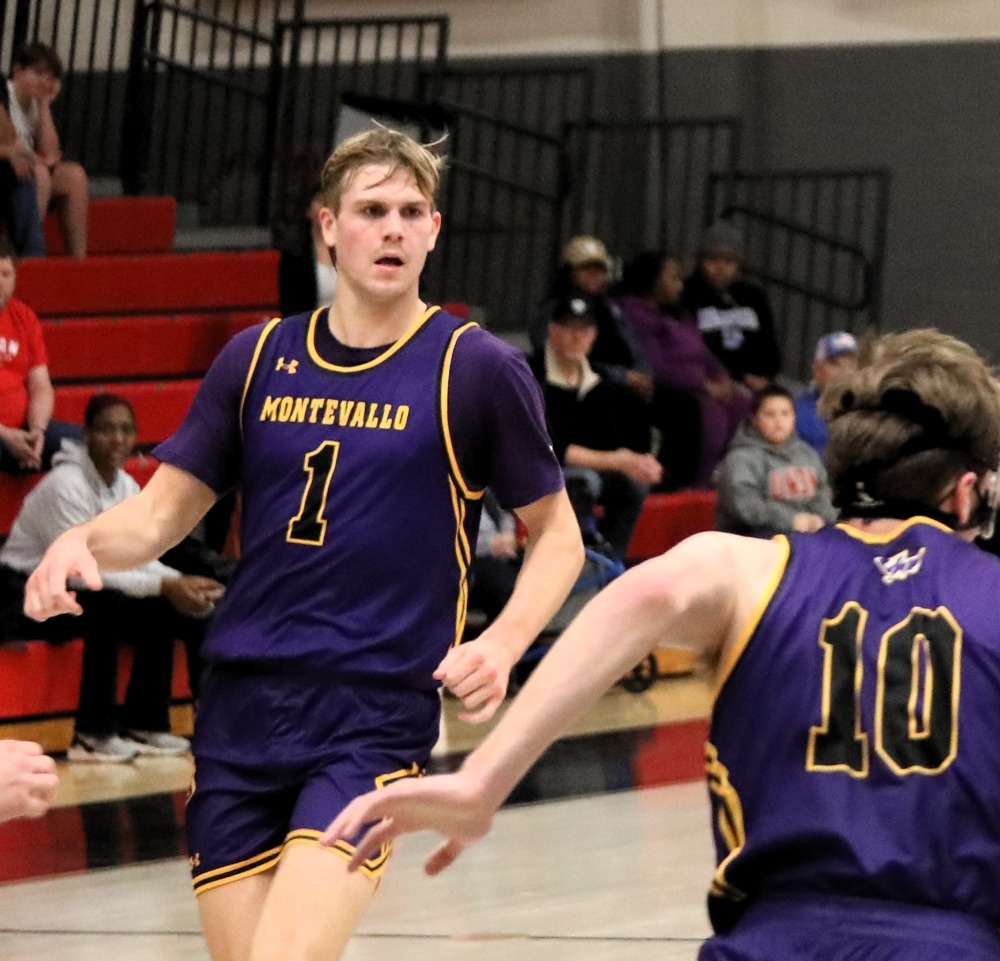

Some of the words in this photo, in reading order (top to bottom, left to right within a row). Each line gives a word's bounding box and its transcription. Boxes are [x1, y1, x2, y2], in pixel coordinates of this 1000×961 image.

[259, 395, 410, 430] MONTEVALLO
[286, 440, 340, 546] 1
[806, 601, 963, 779] 10
